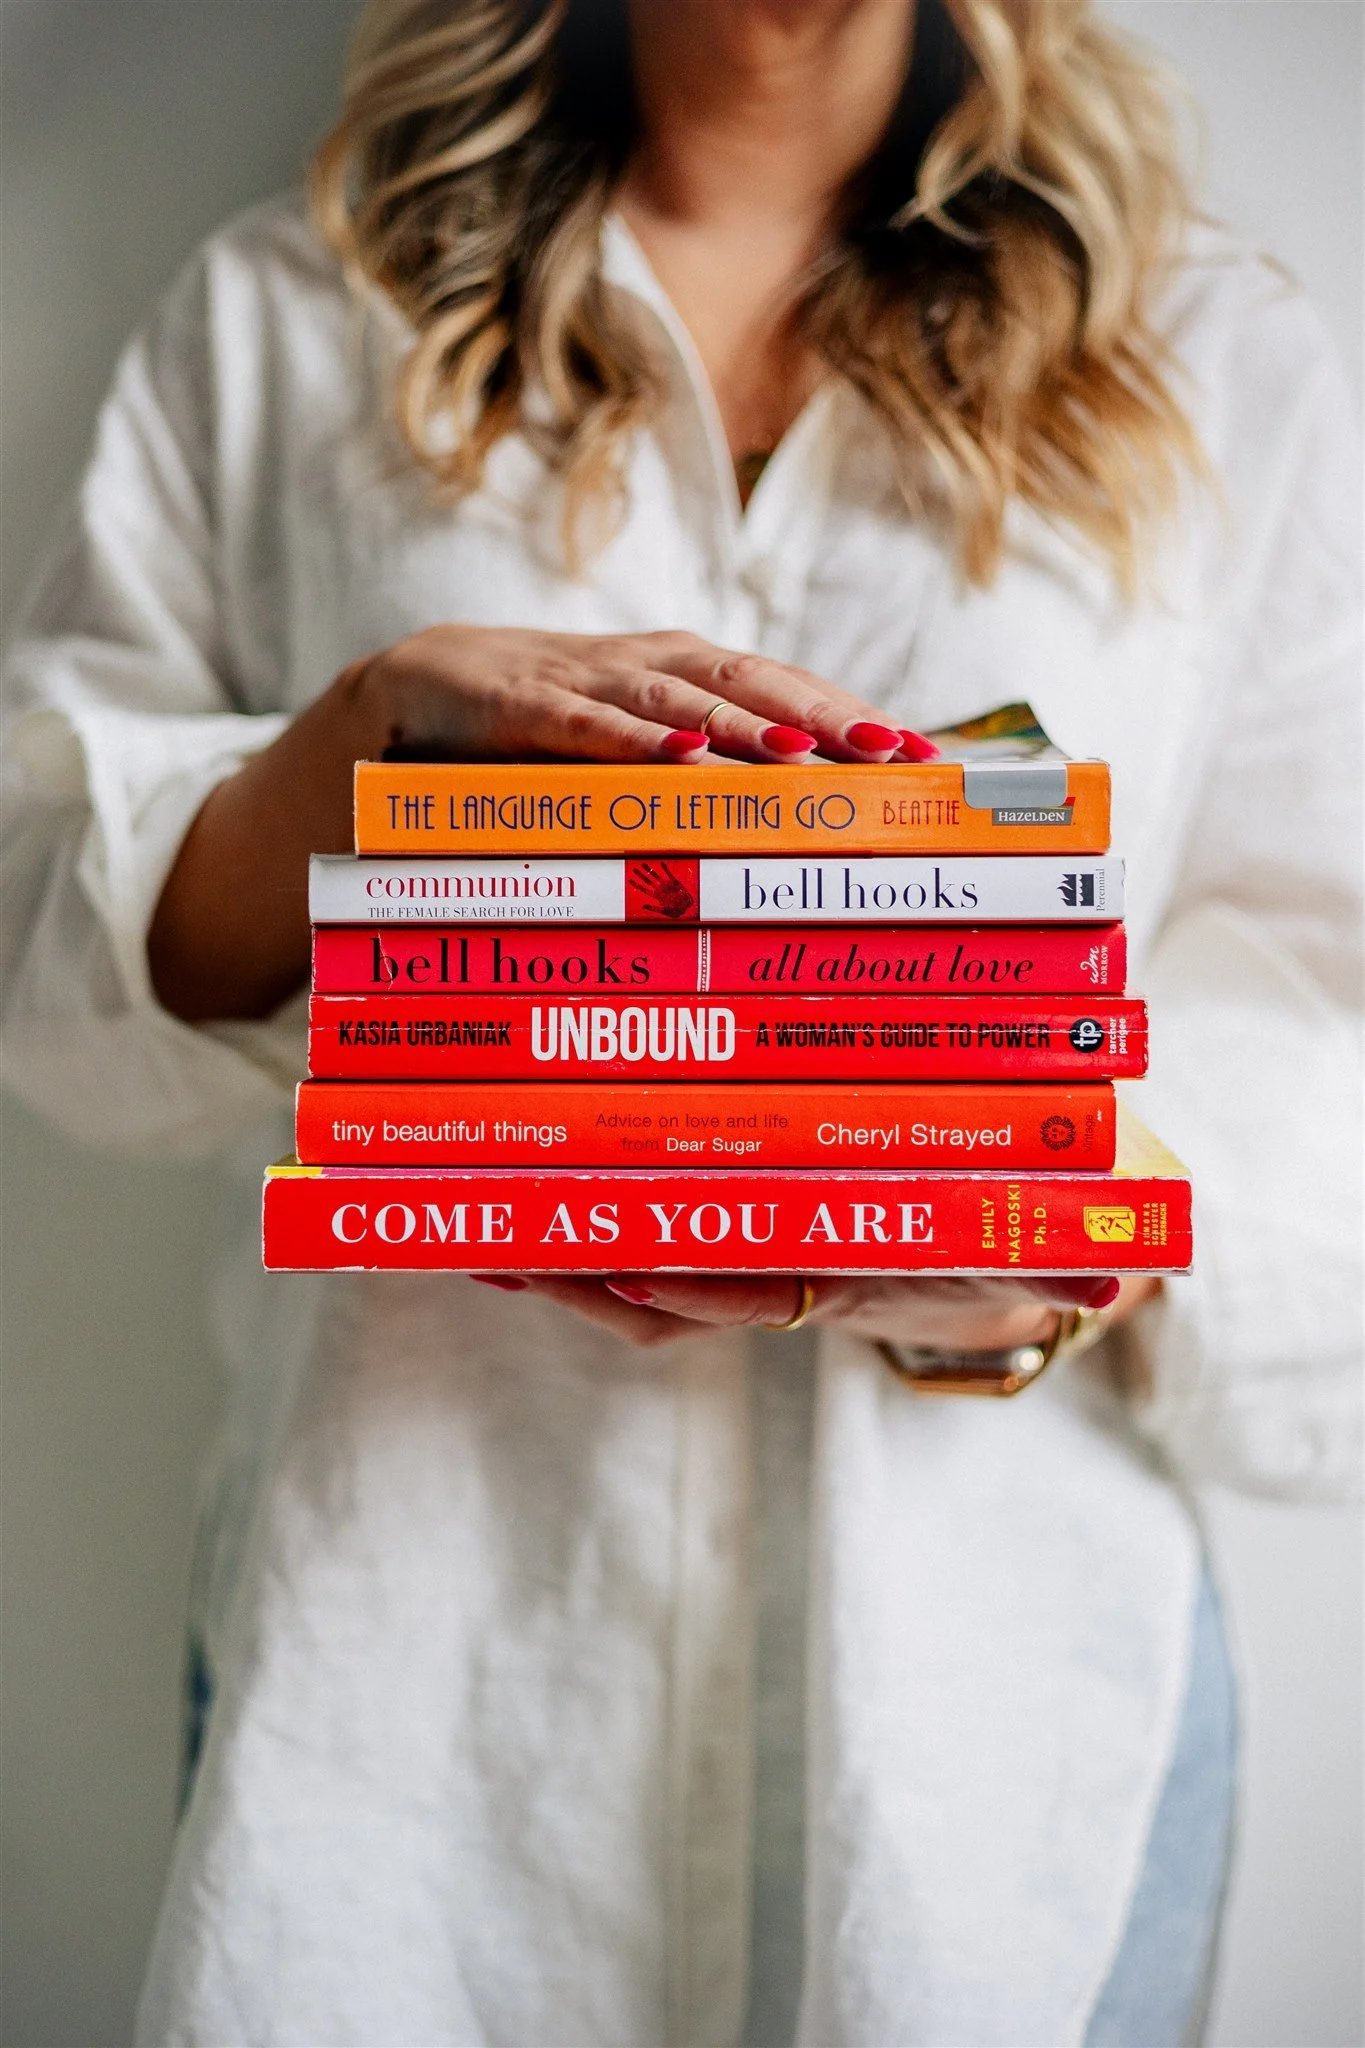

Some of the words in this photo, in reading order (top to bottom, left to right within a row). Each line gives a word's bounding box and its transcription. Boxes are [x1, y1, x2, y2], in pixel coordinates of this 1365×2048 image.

[387, 795, 435, 830] THE
[450, 795, 592, 830] LANGUAGE
[609, 794, 661, 830] OF
[676, 795, 780, 830] LETTING
[796, 794, 856, 830] GO
[883, 800, 960, 826] BEATTIE
[366, 863, 577, 898] communion
[742, 867, 826, 909] bell
[841, 867, 979, 909] hooks
[1095, 868, 1105, 912] Perennial
[368, 907, 394, 918] THE
[398, 907, 450, 918] FEMALE
[453, 906, 505, 917] SEARCH
[510, 906, 535, 917] FOR
[540, 906, 574, 917] LOVE
[370, 937, 471, 984] bell
[489, 937, 650, 984] hooks
[748, 943, 806, 982] all
[816, 943, 936, 983] about
[947, 944, 1034, 983] love
[1100, 945, 1109, 985] MORROW
[339, 1021, 400, 1046] KASIA
[406, 1021, 512, 1047] URBANIAK
[531, 1006, 736, 1062] UNBOUND
[755, 1023, 769, 1048] A
[776, 1022, 875, 1048] WOMAN'S
[880, 1023, 938, 1048] GUIDE
[945, 1023, 971, 1048] TO
[978, 1023, 1051, 1049] POWER
[1108, 1017, 1117, 1055] tarcher
[1117, 1016, 1128, 1055] perigee
[332, 1120, 375, 1147] tiny
[383, 1120, 485, 1142] beautiful
[493, 1120, 567, 1147] things
[595, 1113, 651, 1128] Advice
[658, 1116, 679, 1128] on
[685, 1113, 720, 1128] love
[726, 1113, 757, 1128] and
[763, 1113, 788, 1128] life
[816, 1123, 900, 1150] Cheryl
[910, 1123, 1012, 1151] Strayed
[1083, 1114, 1096, 1153] Vintage
[621, 1137, 659, 1151] from
[666, 1137, 706, 1152] Dear
[712, 1137, 762, 1155] Sugar
[331, 1203, 514, 1244] COME
[539, 1203, 620, 1244] AS
[646, 1203, 779, 1243] YOU
[800, 1203, 934, 1243] ARE
[982, 1198, 995, 1249] EMILY
[1007, 1184, 1021, 1263] NAGOSKI
[1034, 1202, 1047, 1245] Ph.D.
[1151, 1203, 1159, 1246] SCHUSTER
